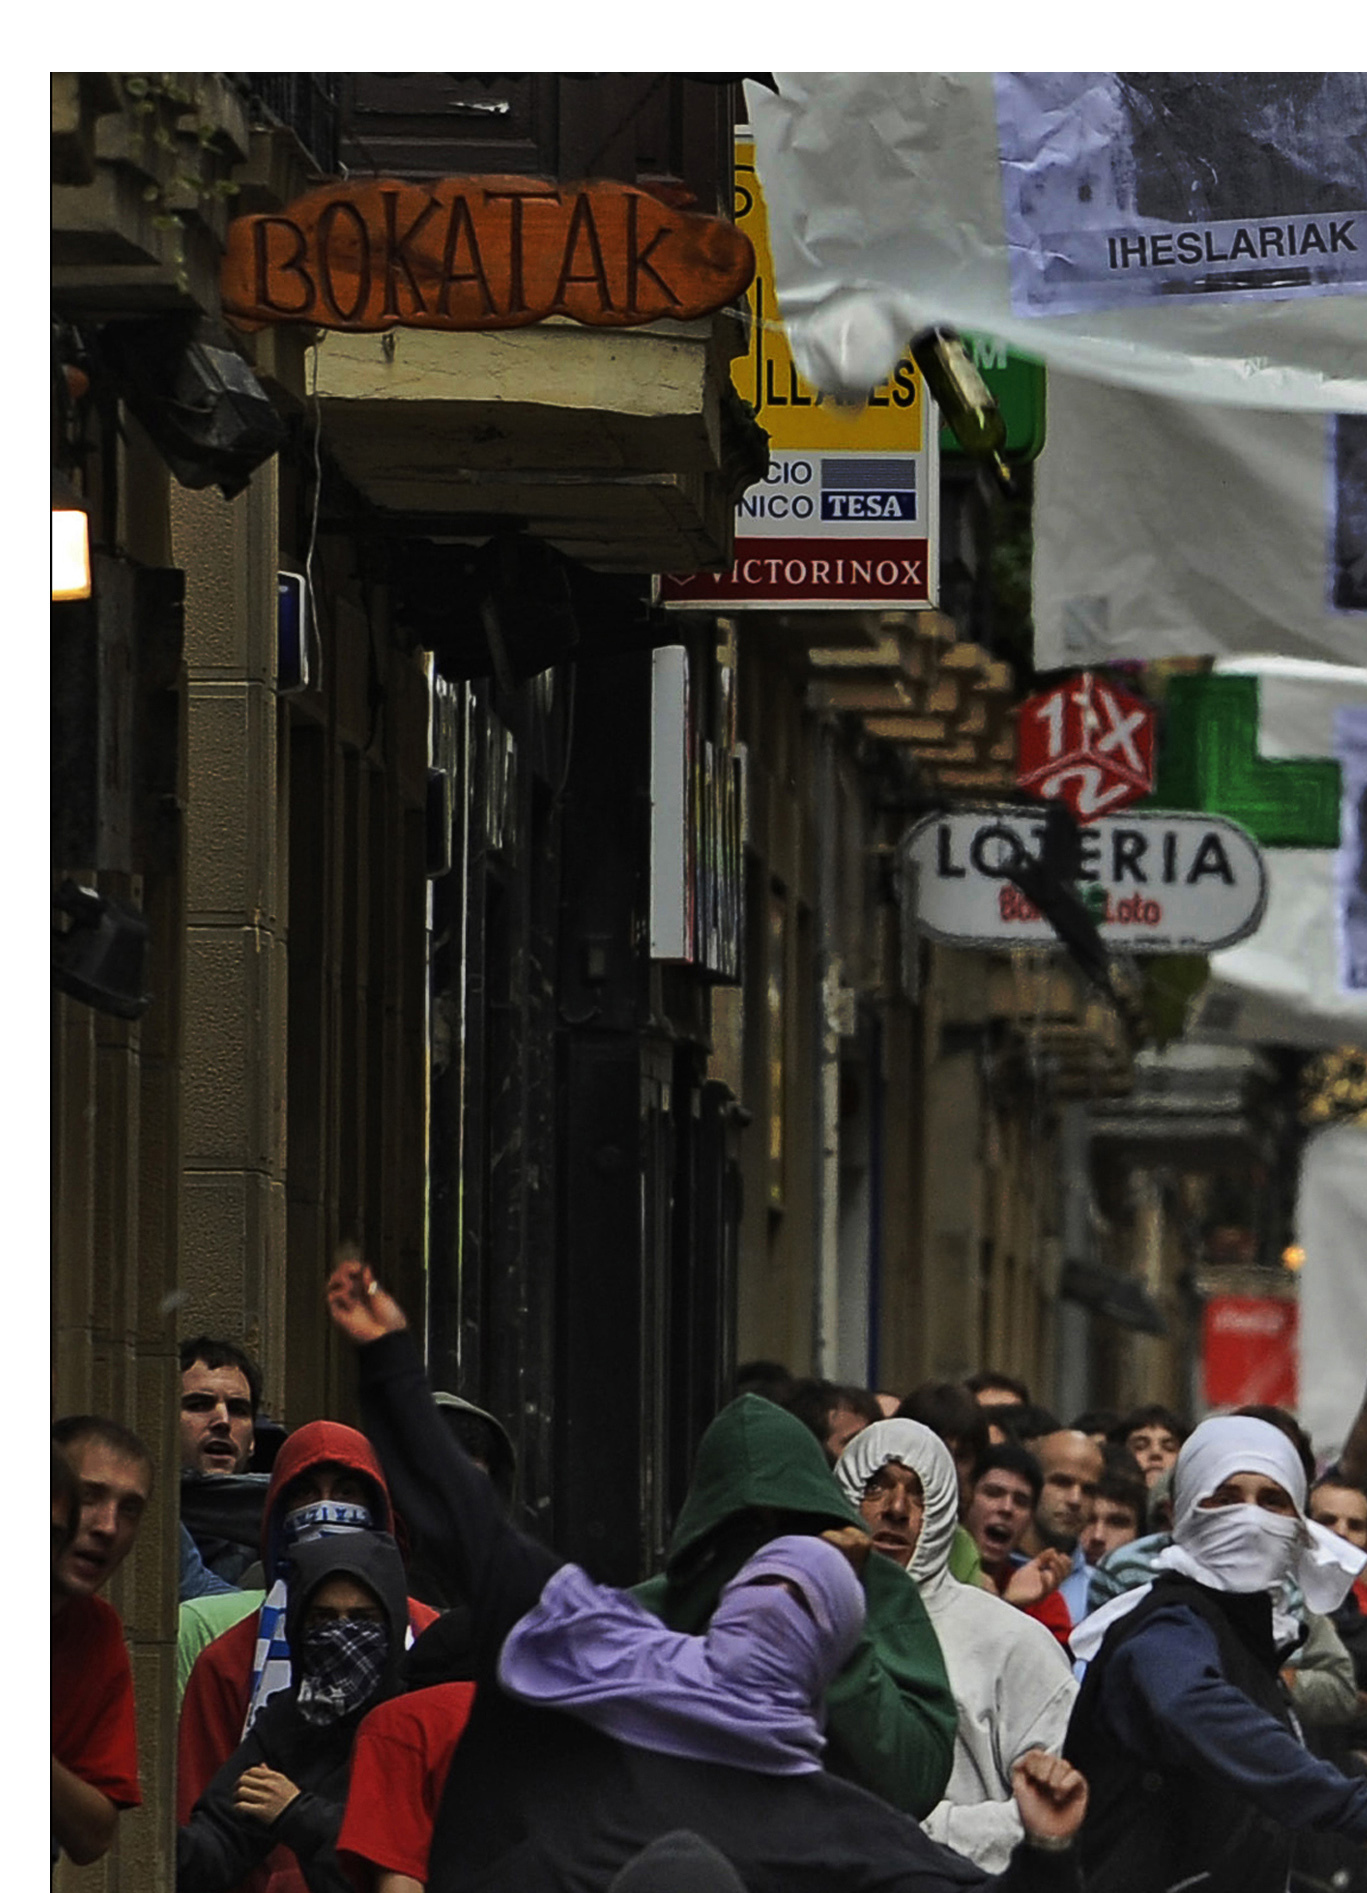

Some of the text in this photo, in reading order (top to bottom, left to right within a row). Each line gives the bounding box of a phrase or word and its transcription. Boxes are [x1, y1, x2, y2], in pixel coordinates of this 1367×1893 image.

[255, 193, 683, 321] BOKATAK
[1107, 219, 1358, 269] IHESLARIAK
[828, 494, 902, 517] TESA
[711, 559, 922, 585] VICTORINOX
[1037, 692, 1063, 756] 1
